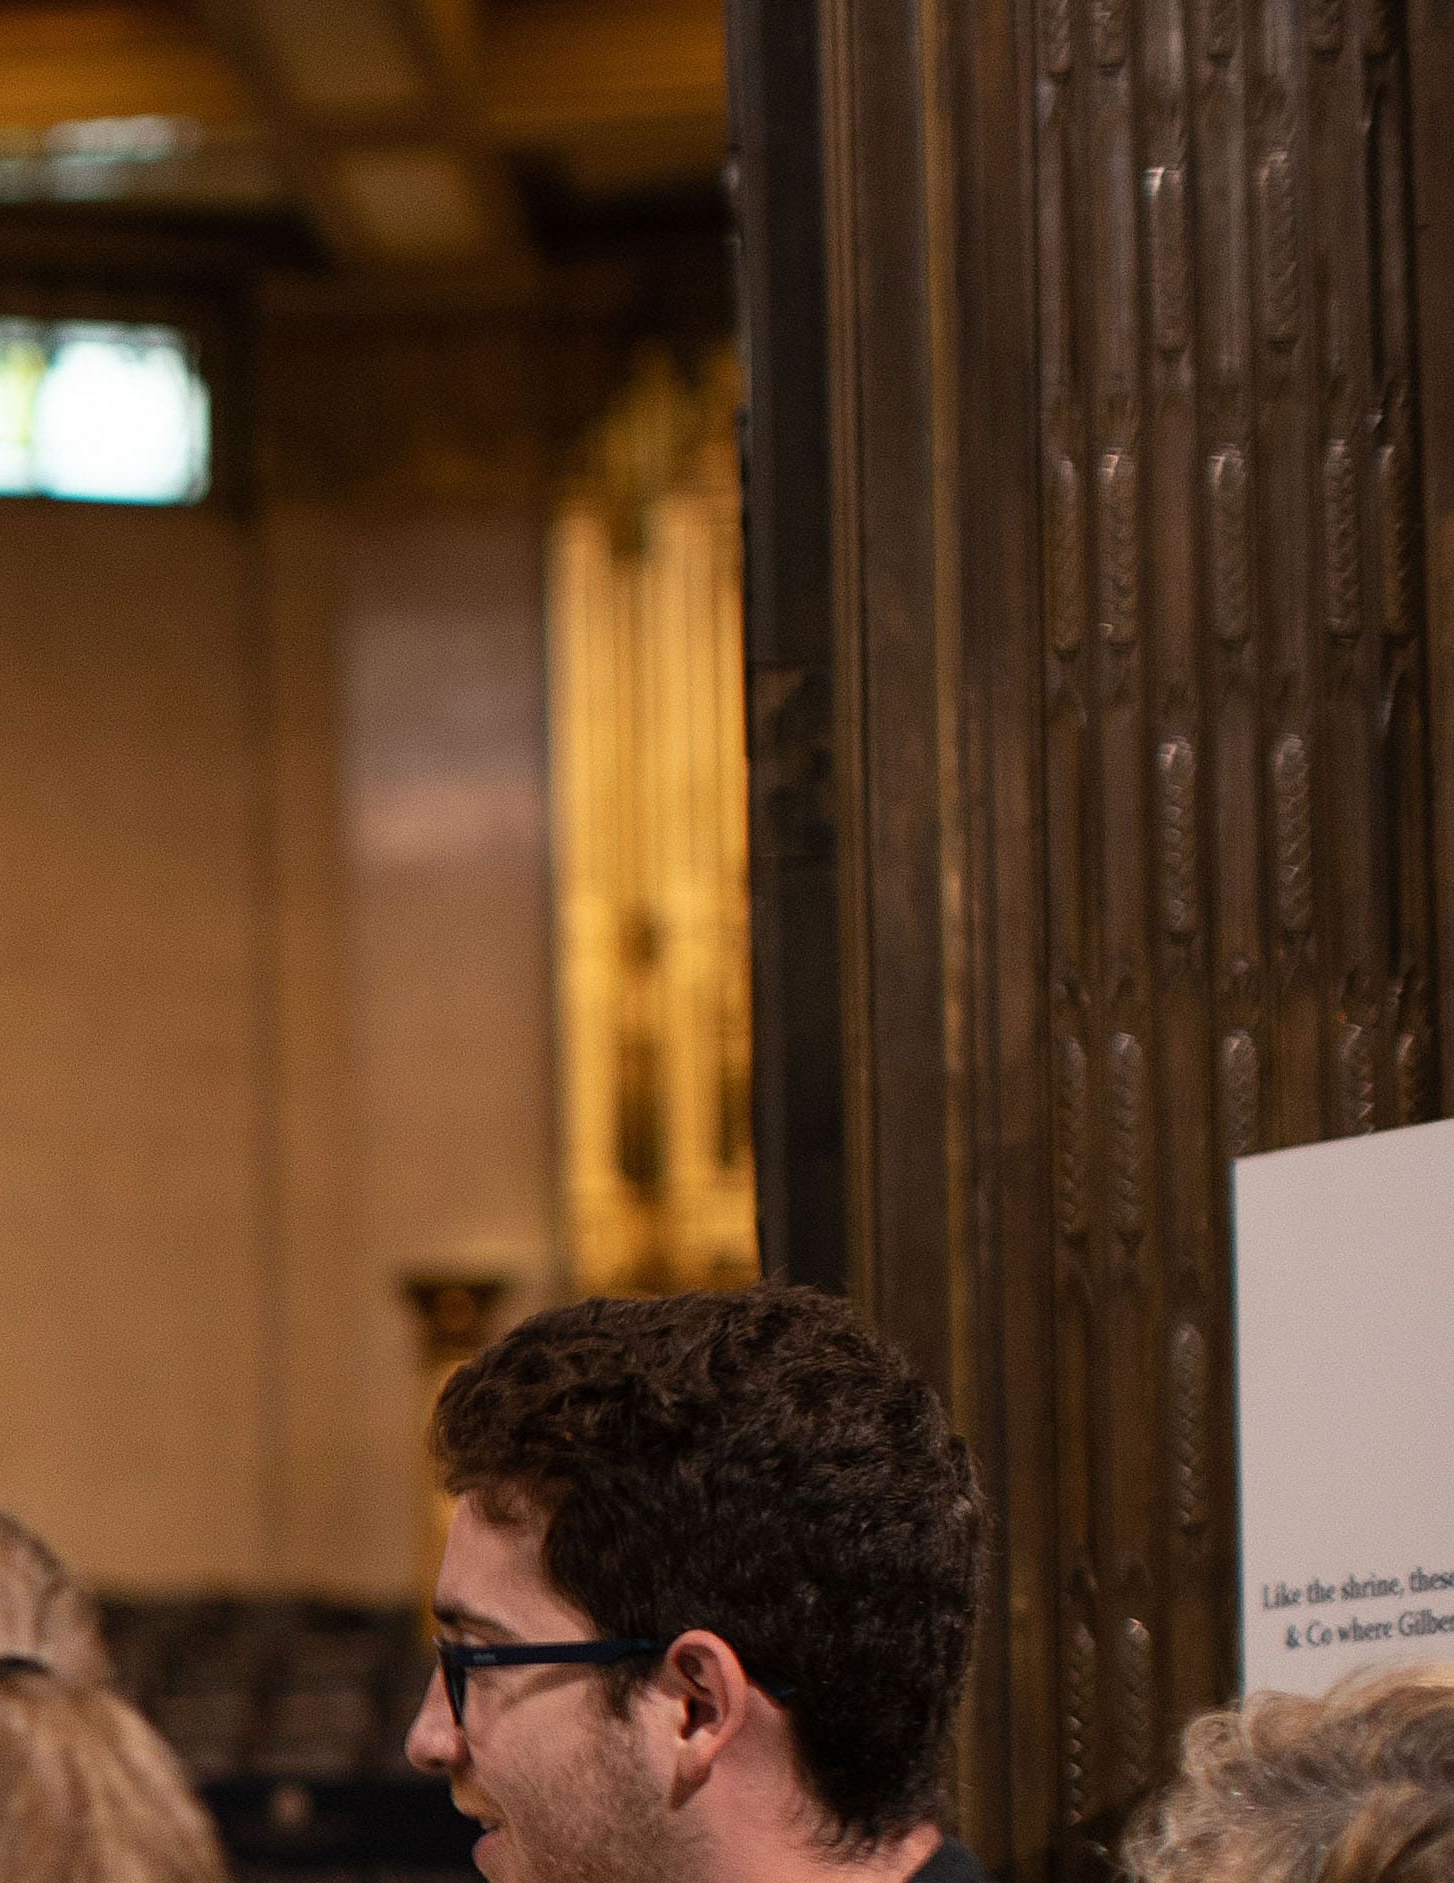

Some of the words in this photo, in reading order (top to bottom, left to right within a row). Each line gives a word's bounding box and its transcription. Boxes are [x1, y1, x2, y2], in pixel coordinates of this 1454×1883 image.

[1263, 1583, 1301, 1610] Like
[1306, 1579, 1336, 1604] the
[1340, 1573, 1404, 1600] shrine,
[1286, 1624, 1301, 1649] &
[1306, 1620, 1333, 1647] Co
[1338, 1616, 1393, 1643] where
